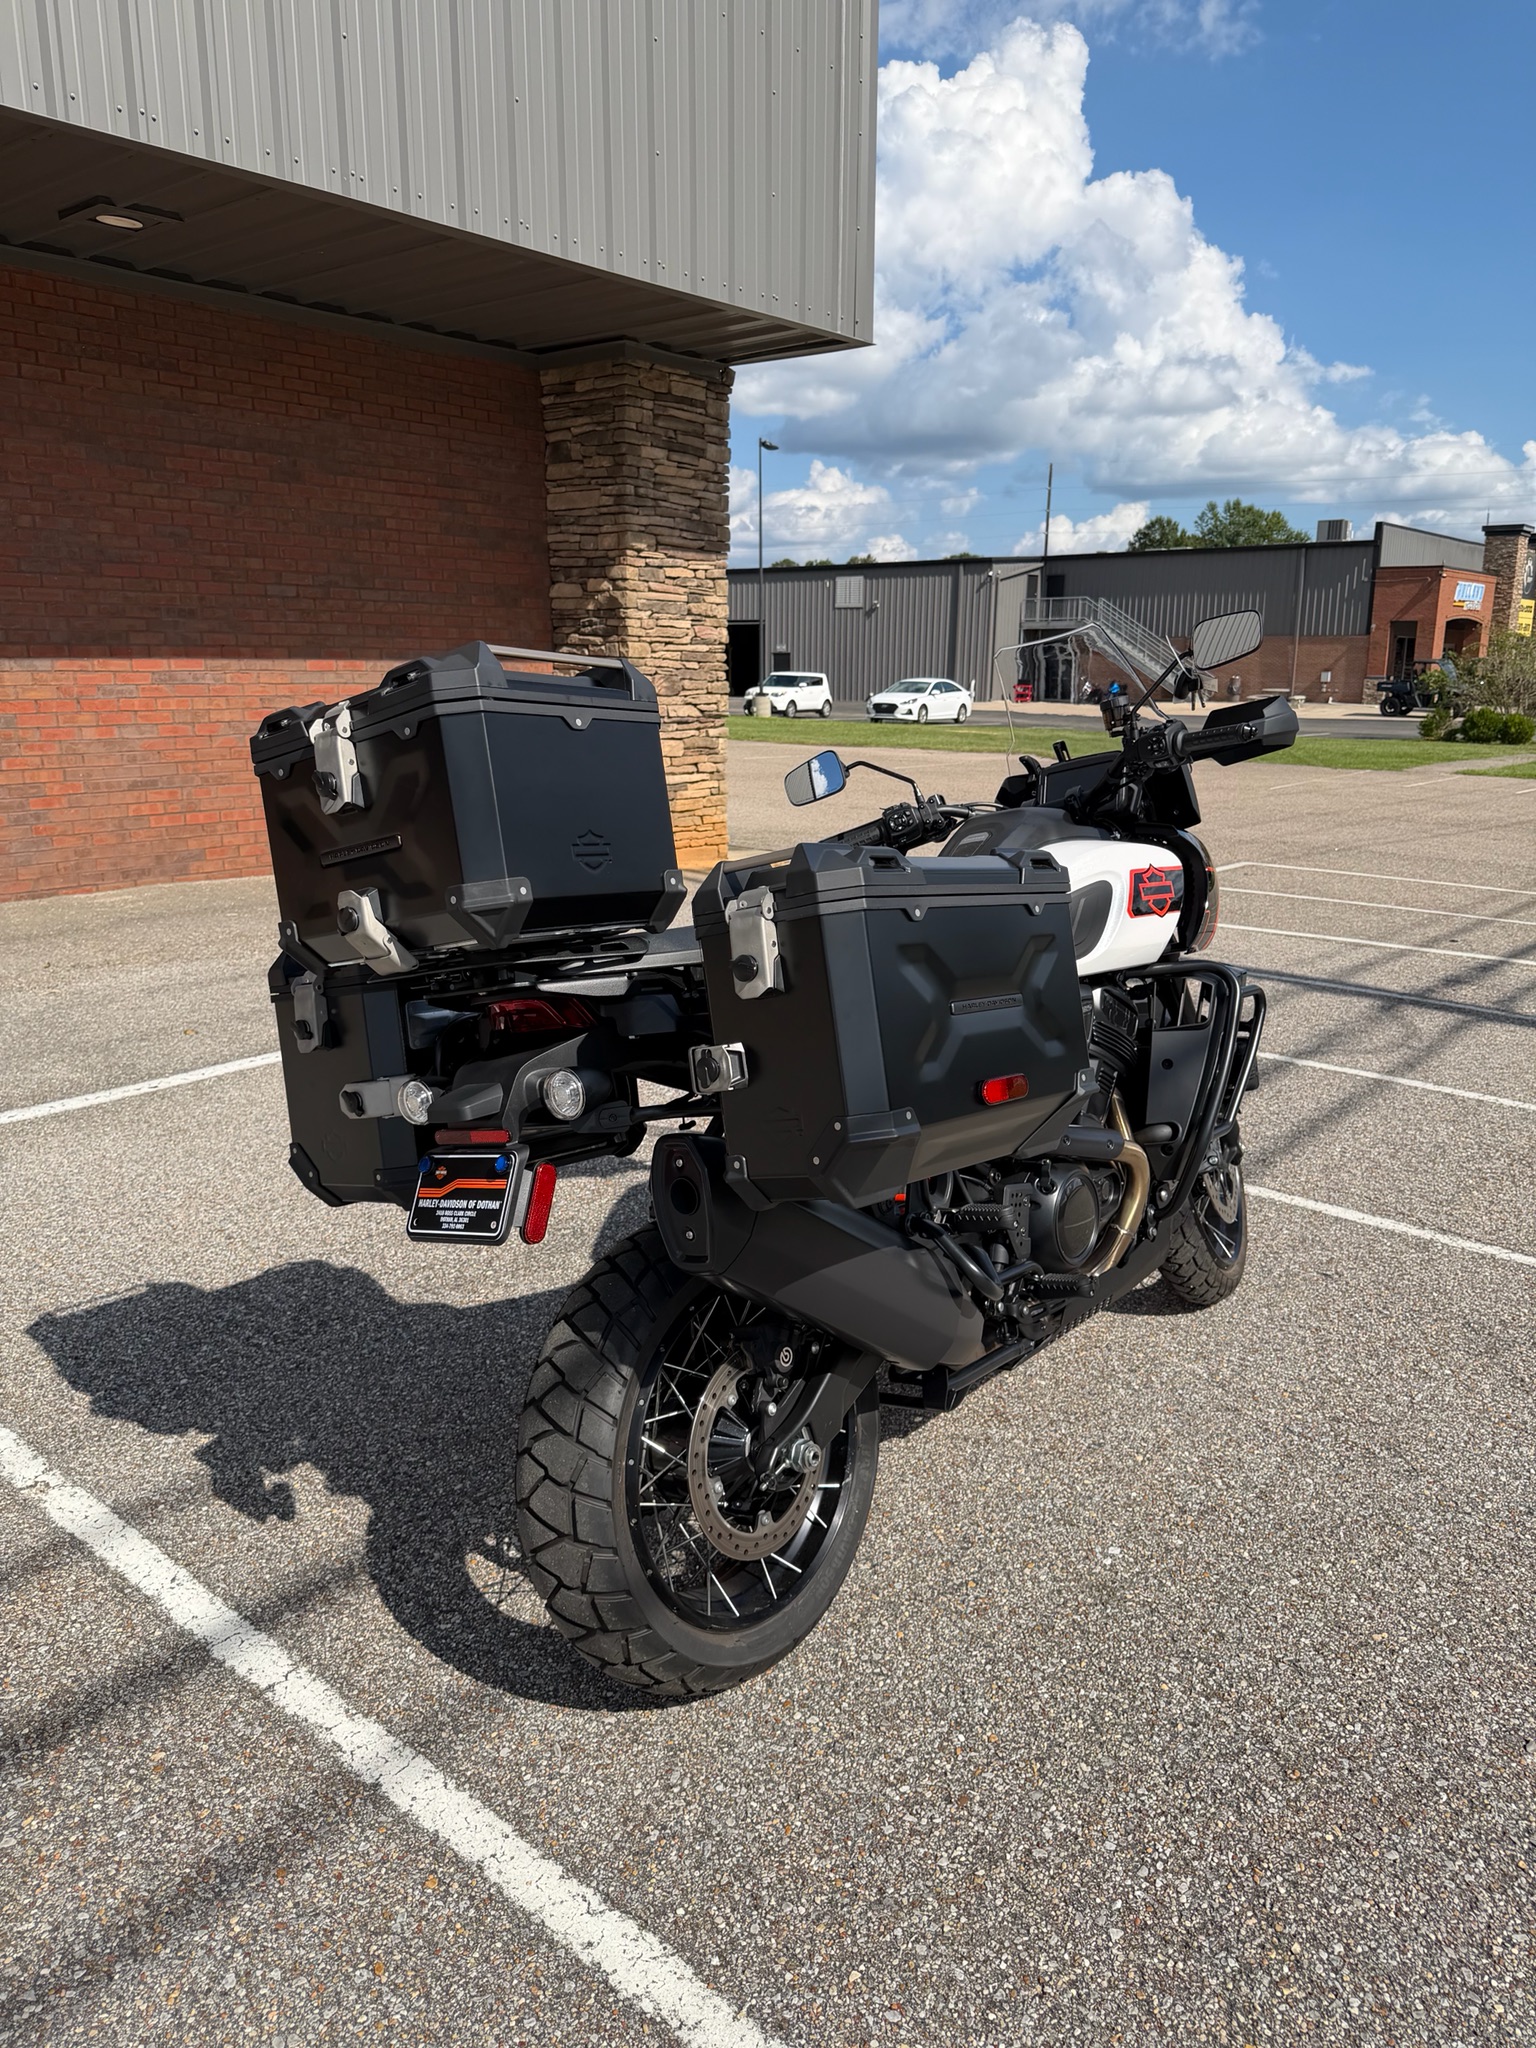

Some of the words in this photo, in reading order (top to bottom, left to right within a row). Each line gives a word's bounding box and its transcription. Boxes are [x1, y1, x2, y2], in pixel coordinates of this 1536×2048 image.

[418, 1199, 467, 1209] HARLEY-DAVIDSON
[468, 1200, 476, 1209] OF
[476, 1200, 501, 1210] DOTHAN
